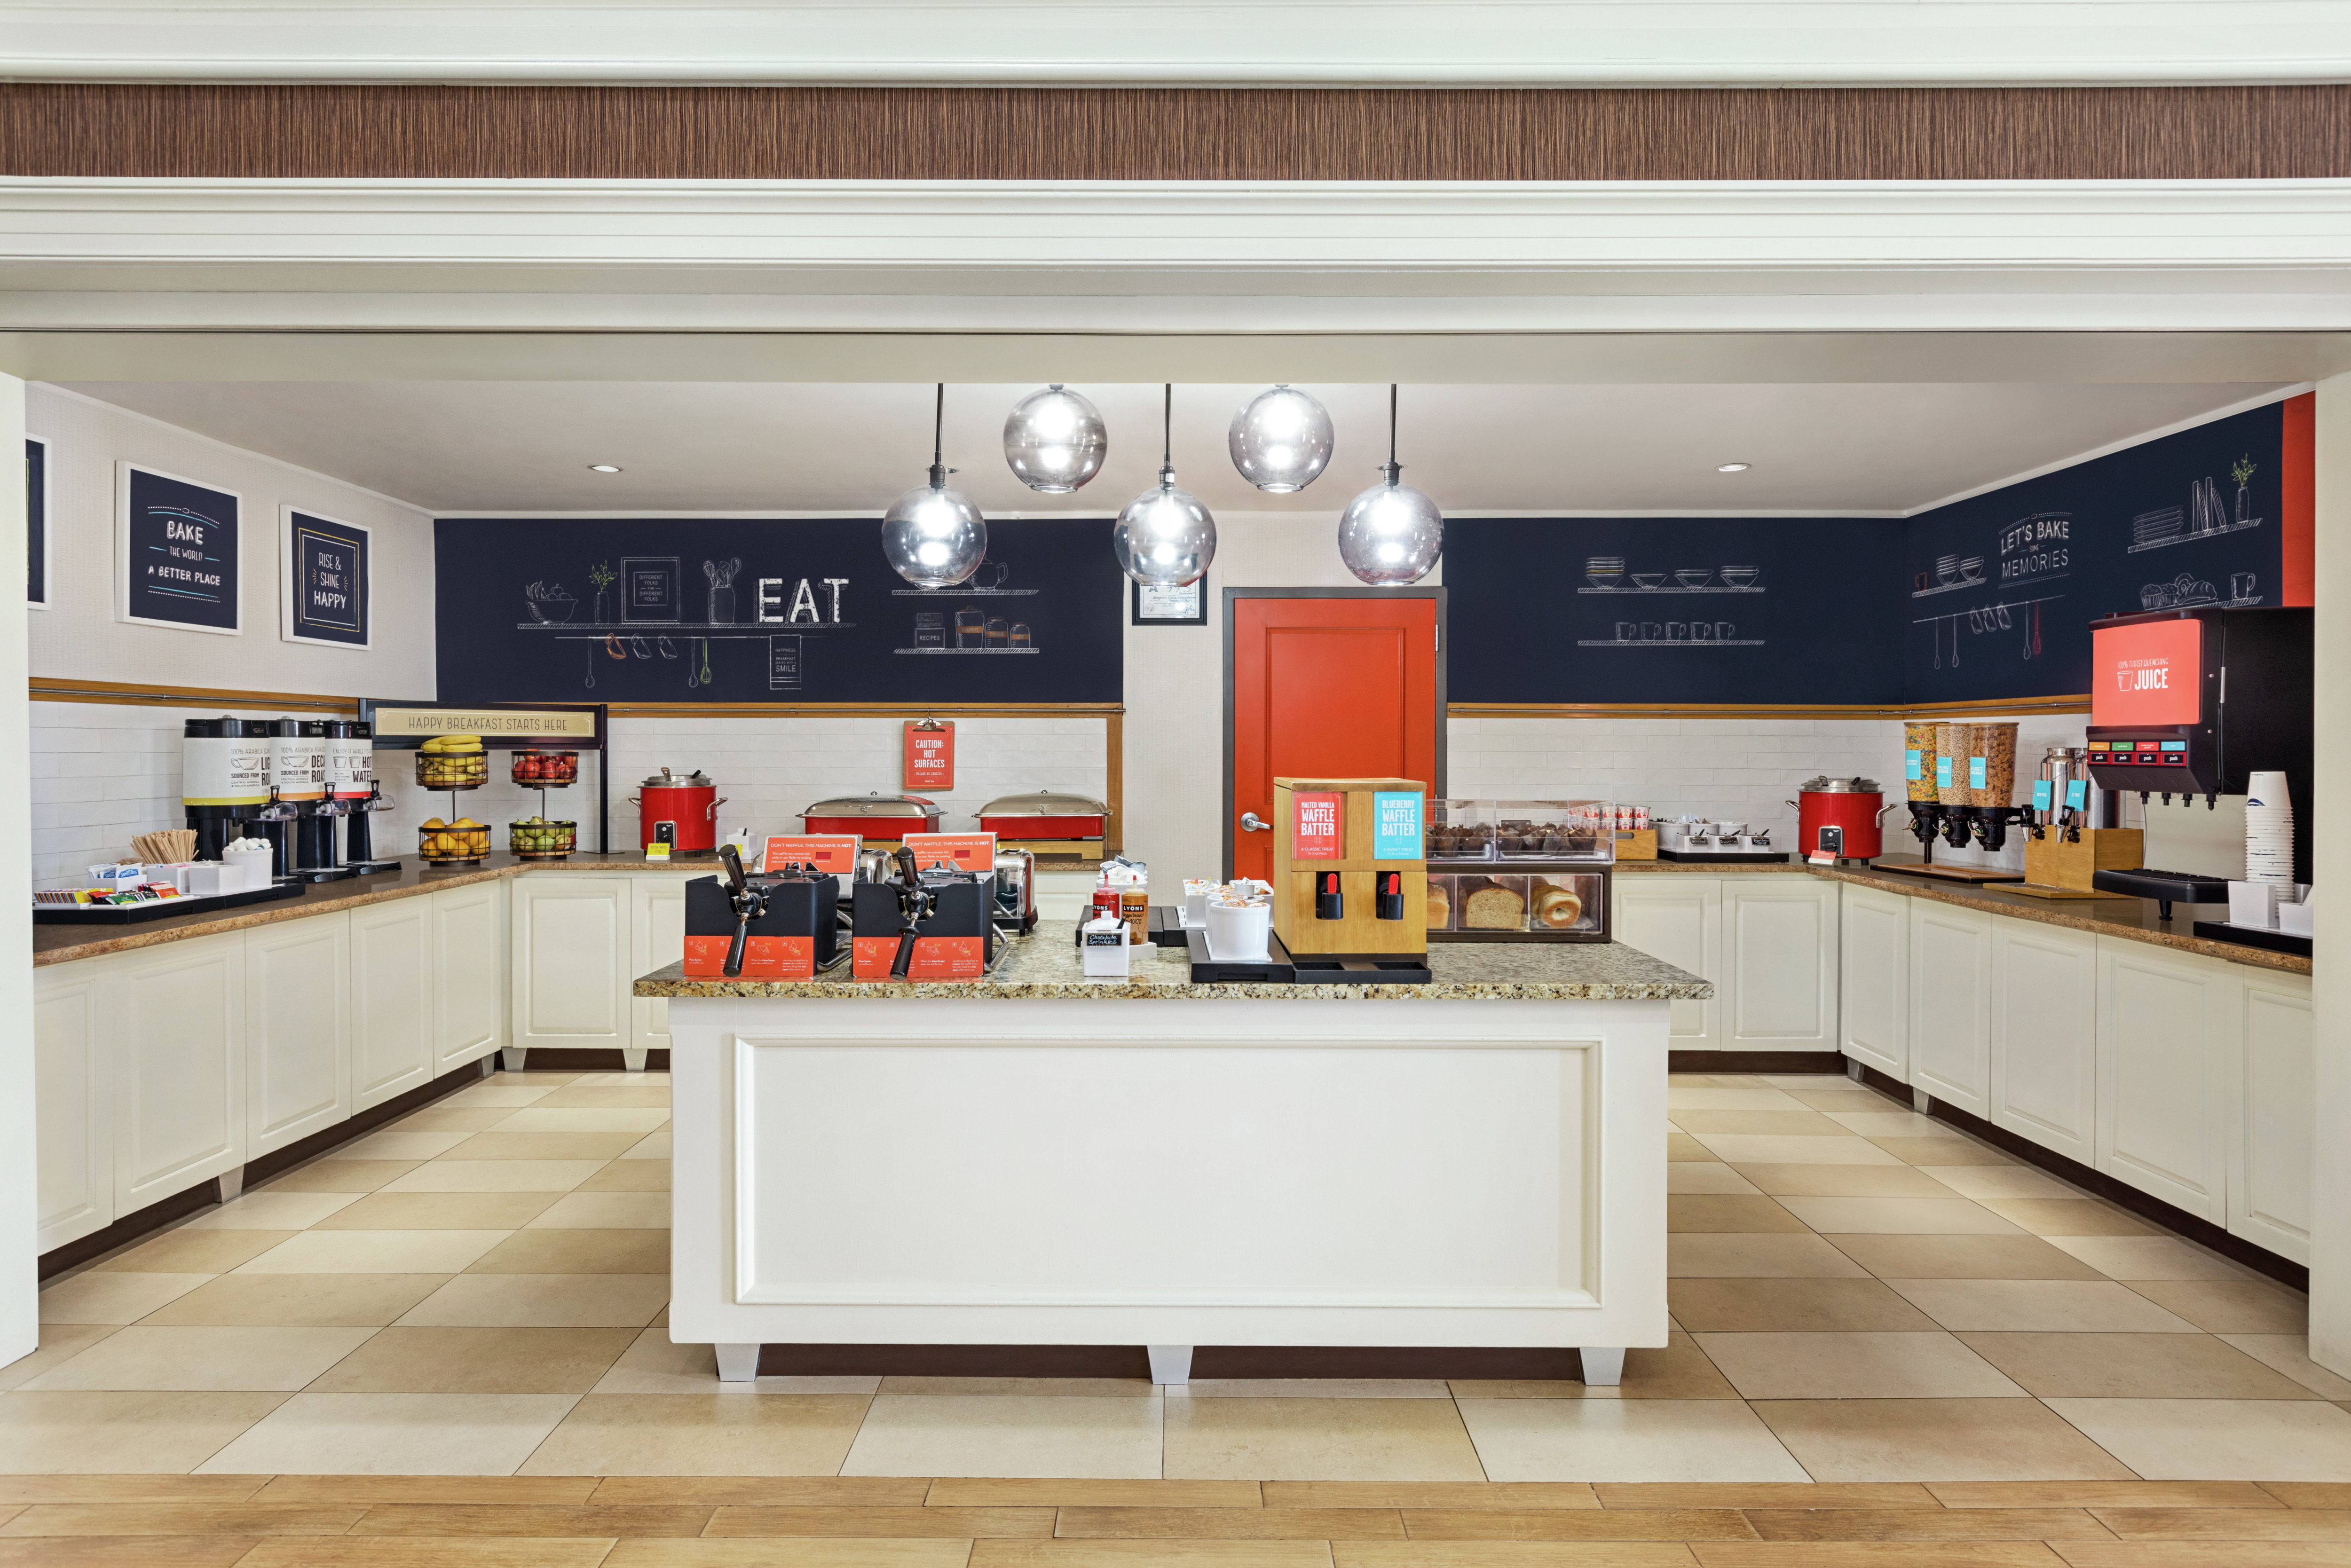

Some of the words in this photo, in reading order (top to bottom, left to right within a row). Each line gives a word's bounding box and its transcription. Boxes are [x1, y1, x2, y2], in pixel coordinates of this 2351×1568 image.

[167, 520, 203, 545] BAKE
[2001, 524, 2032, 556] LET'S
[2037, 520, 2069, 540] BAKE
[170, 546, 180, 557] THE
[182, 548, 203, 561] WORLD
[2029, 544, 2039, 552] SOME
[319, 552, 333, 569] RISE
[335, 556, 341, 570] &
[2002, 549, 2068, 579] MEMORIES
[148, 565, 154, 575] A
[158, 566, 191, 582] BETTER
[195, 572, 221, 586] PLACE
[320, 572, 339, 589] SHINE
[314, 590, 347, 609] HAPPY
[759, 578, 849, 623] EAT
[2129, 659, 2143, 668] THIRST
[2144, 657, 2169, 667] QUENCHING
[2134, 668, 2168, 690] JUICE
[409, 717, 442, 729] HAPPY
[447, 717, 503, 730] BREAKFAST
[506, 718, 540, 730] STARTS
[544, 719, 567, 731] HERE
[915, 740, 944, 749] CAUTION:
[923, 749, 936, 758] HOT
[363, 756, 371, 768] HOT
[914, 759, 945, 768] SURFACES
[353, 771, 371, 782] WATER
[1382, 800, 1415, 808] BLUEBERRY
[1302, 809, 1334, 822] WAFFLE
[1382, 809, 1415, 822] WAFFLE
[1301, 823, 1334, 835] BATTER
[1382, 823, 1415, 836] BATTER
